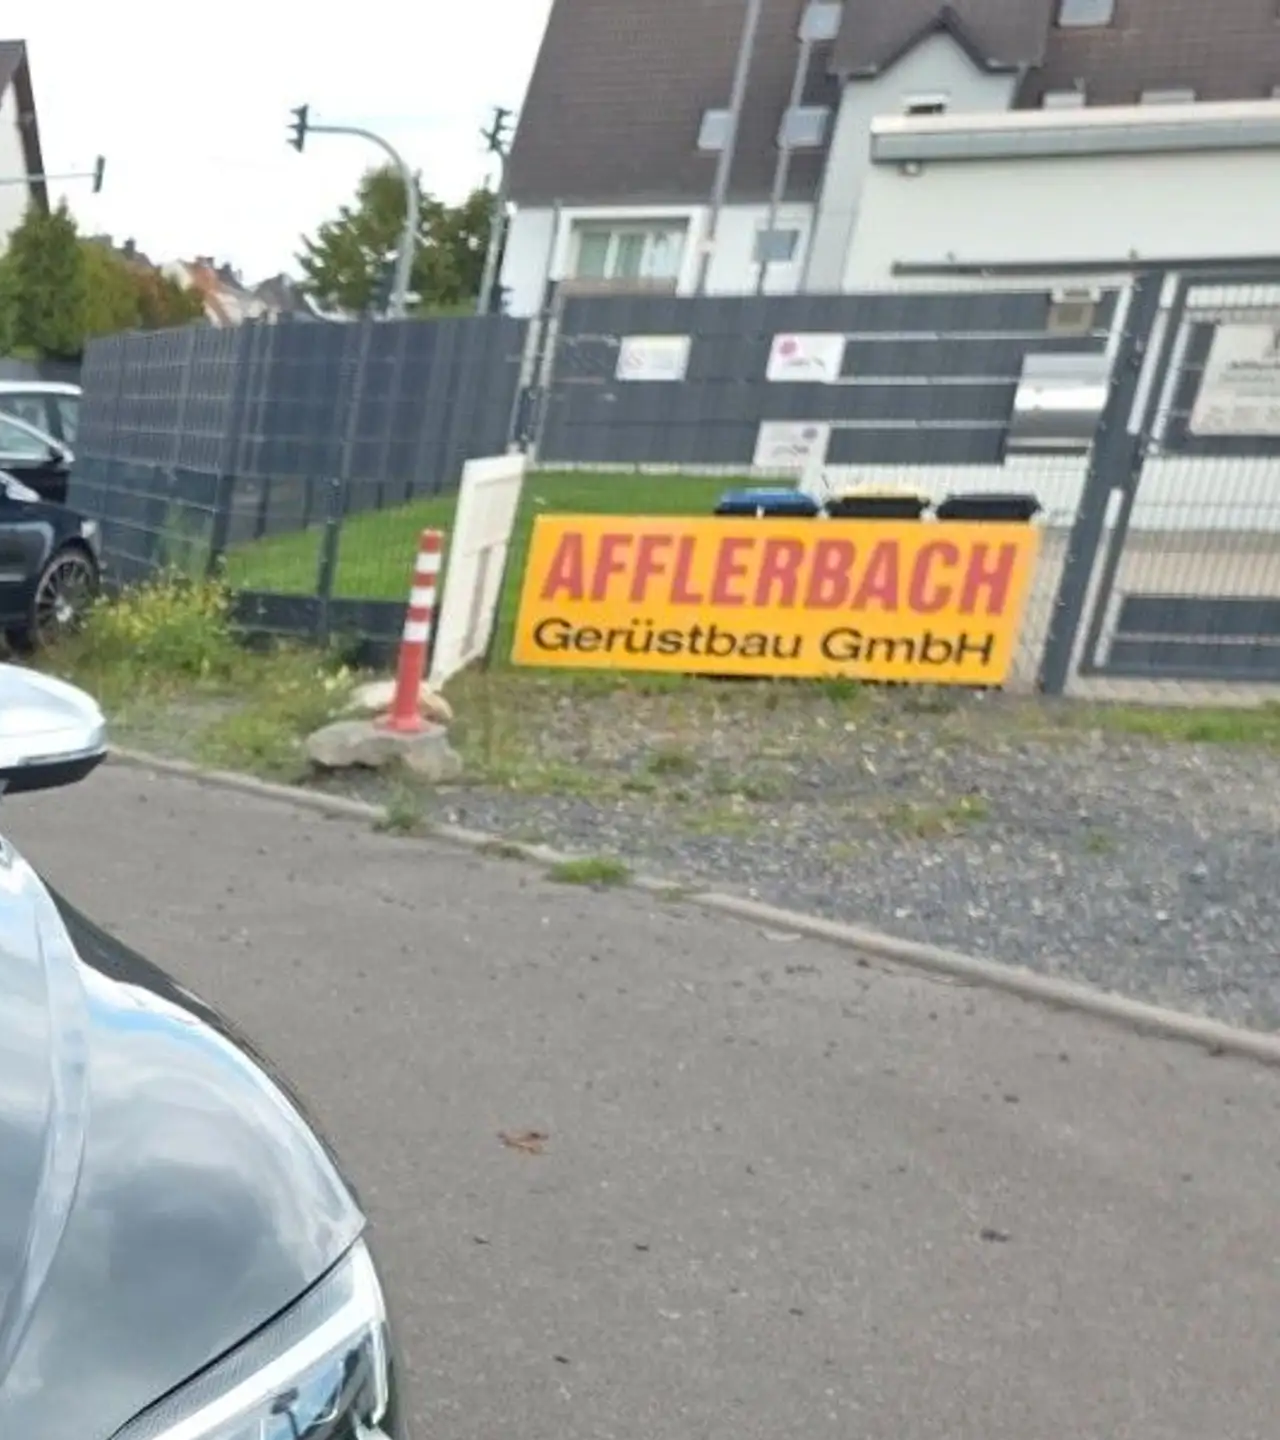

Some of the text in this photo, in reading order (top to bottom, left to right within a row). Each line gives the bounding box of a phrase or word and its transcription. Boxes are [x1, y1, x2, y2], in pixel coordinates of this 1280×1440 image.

[540, 531, 1017, 617] AFFLERBACH
[533, 617, 995, 666] Gerüstbau GmbH
